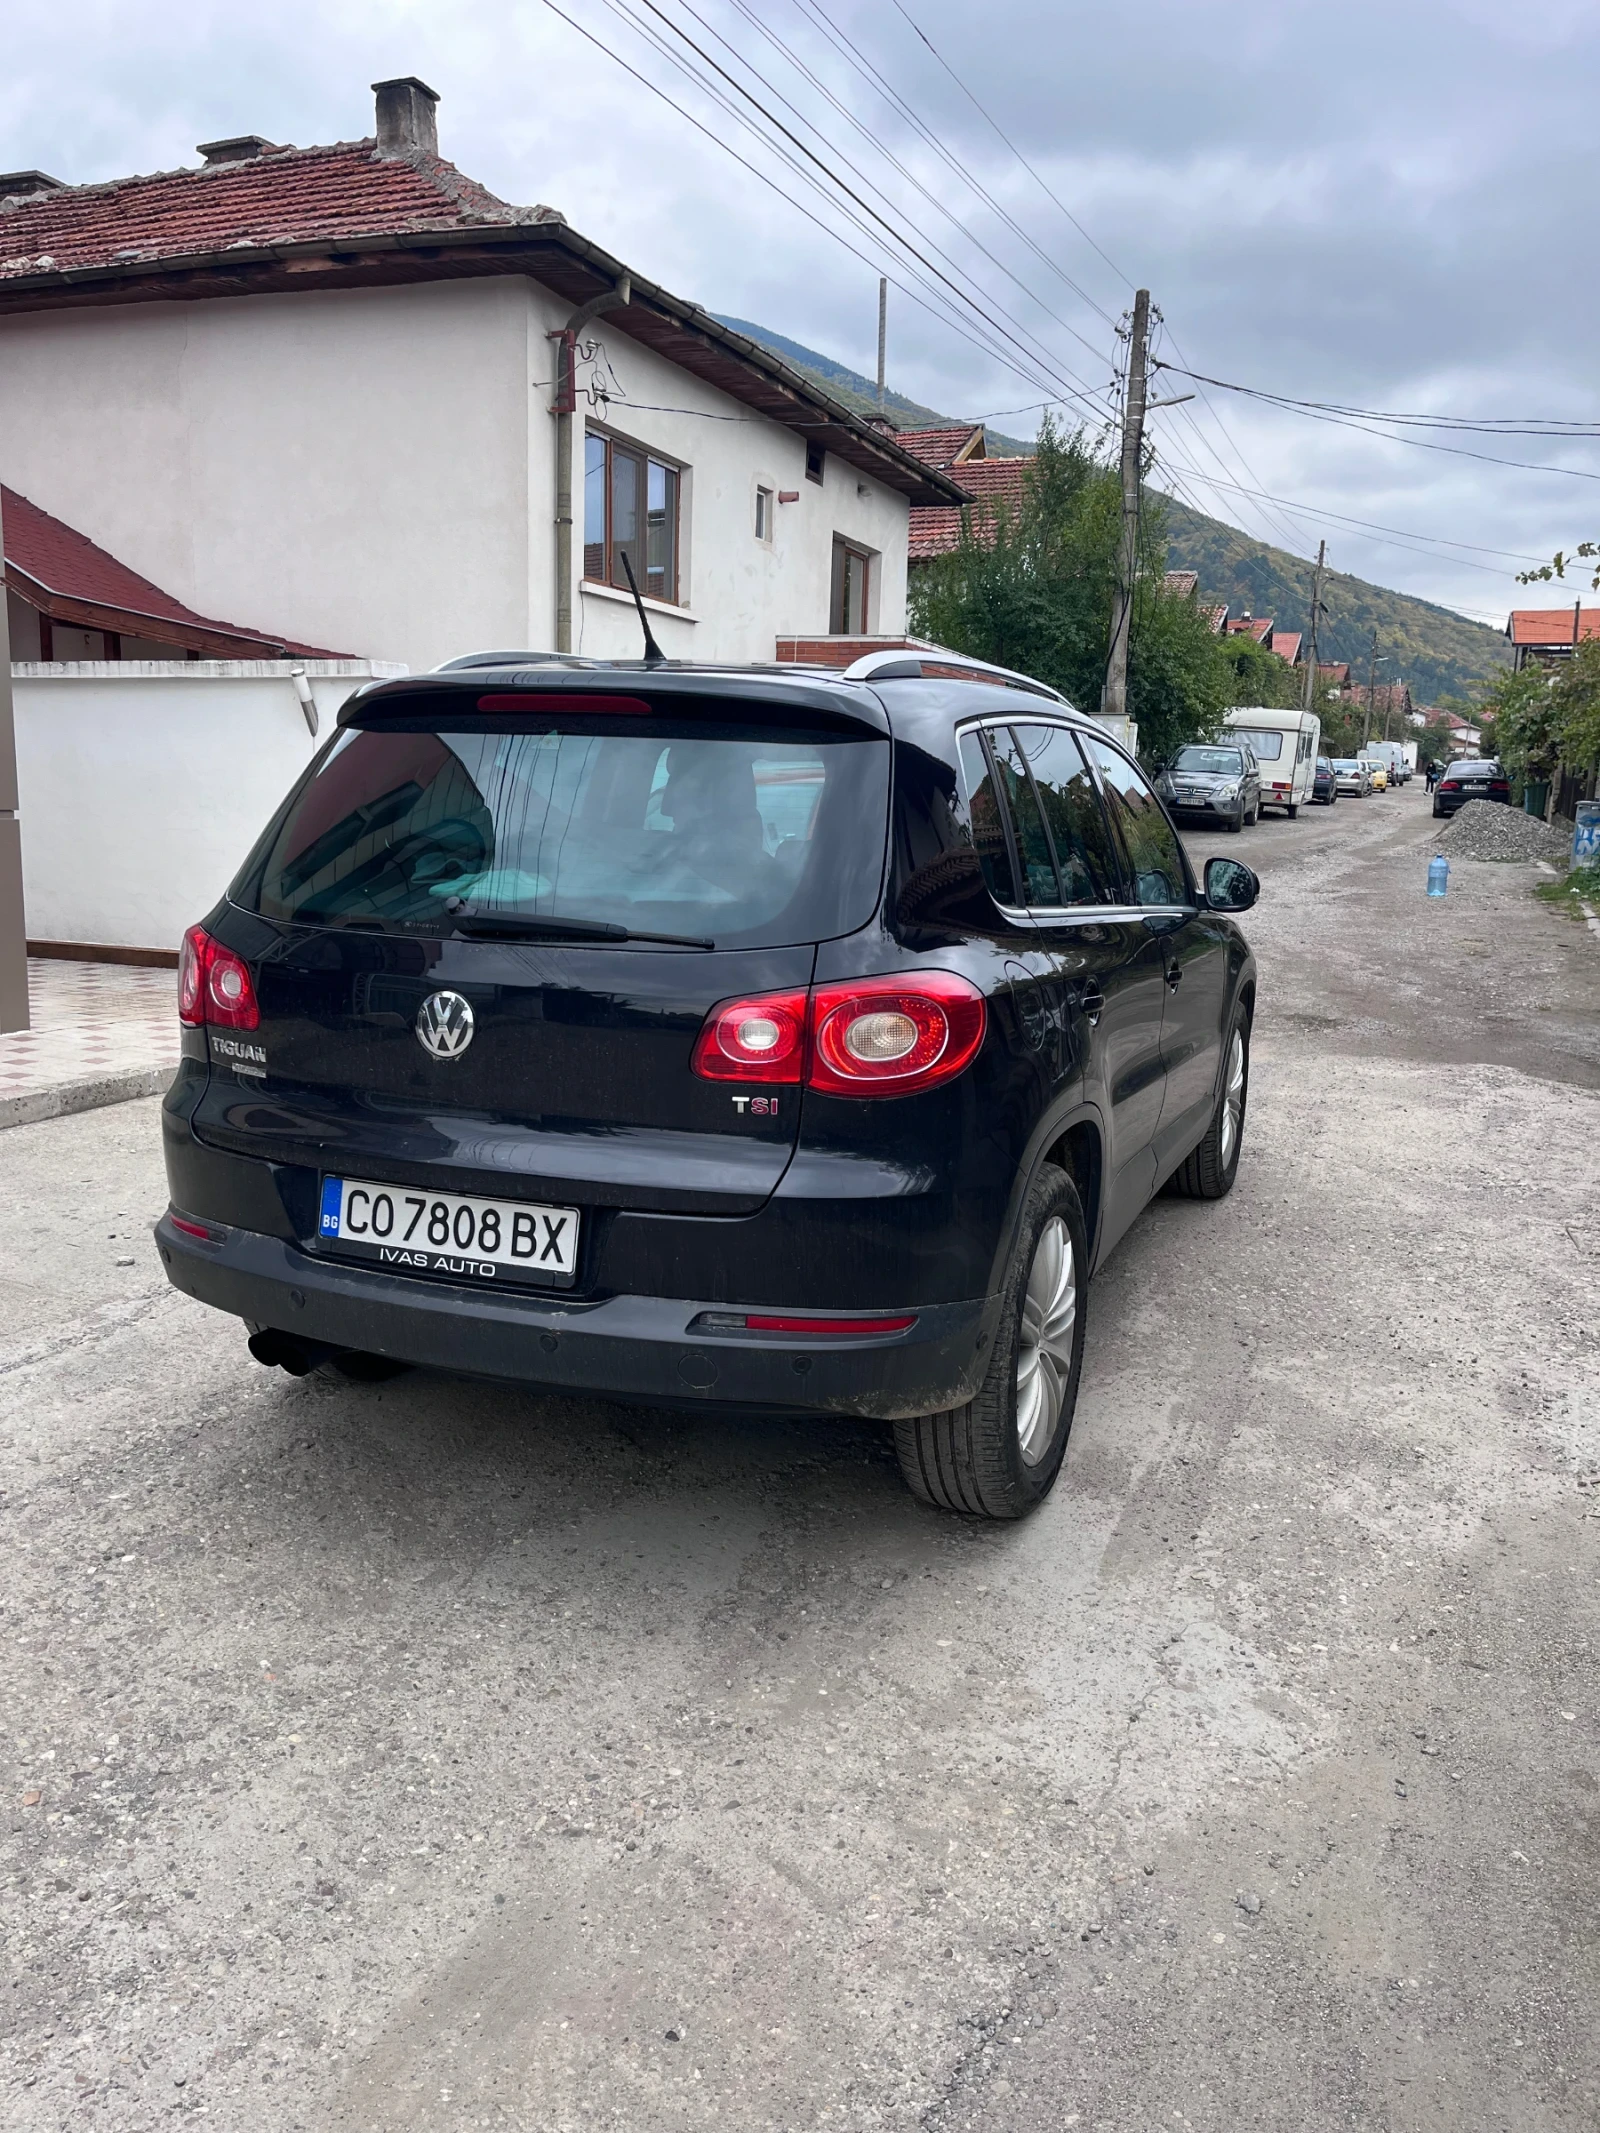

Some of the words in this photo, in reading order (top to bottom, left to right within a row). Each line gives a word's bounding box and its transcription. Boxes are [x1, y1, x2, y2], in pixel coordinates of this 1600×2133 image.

[211, 1036, 267, 1063] TIGUAN
[731, 1096, 779, 1115] TSI
[322, 1214, 339, 1229] BG
[379, 1247, 428, 1268] IVAS
[433, 1260, 496, 1277] AUTO
